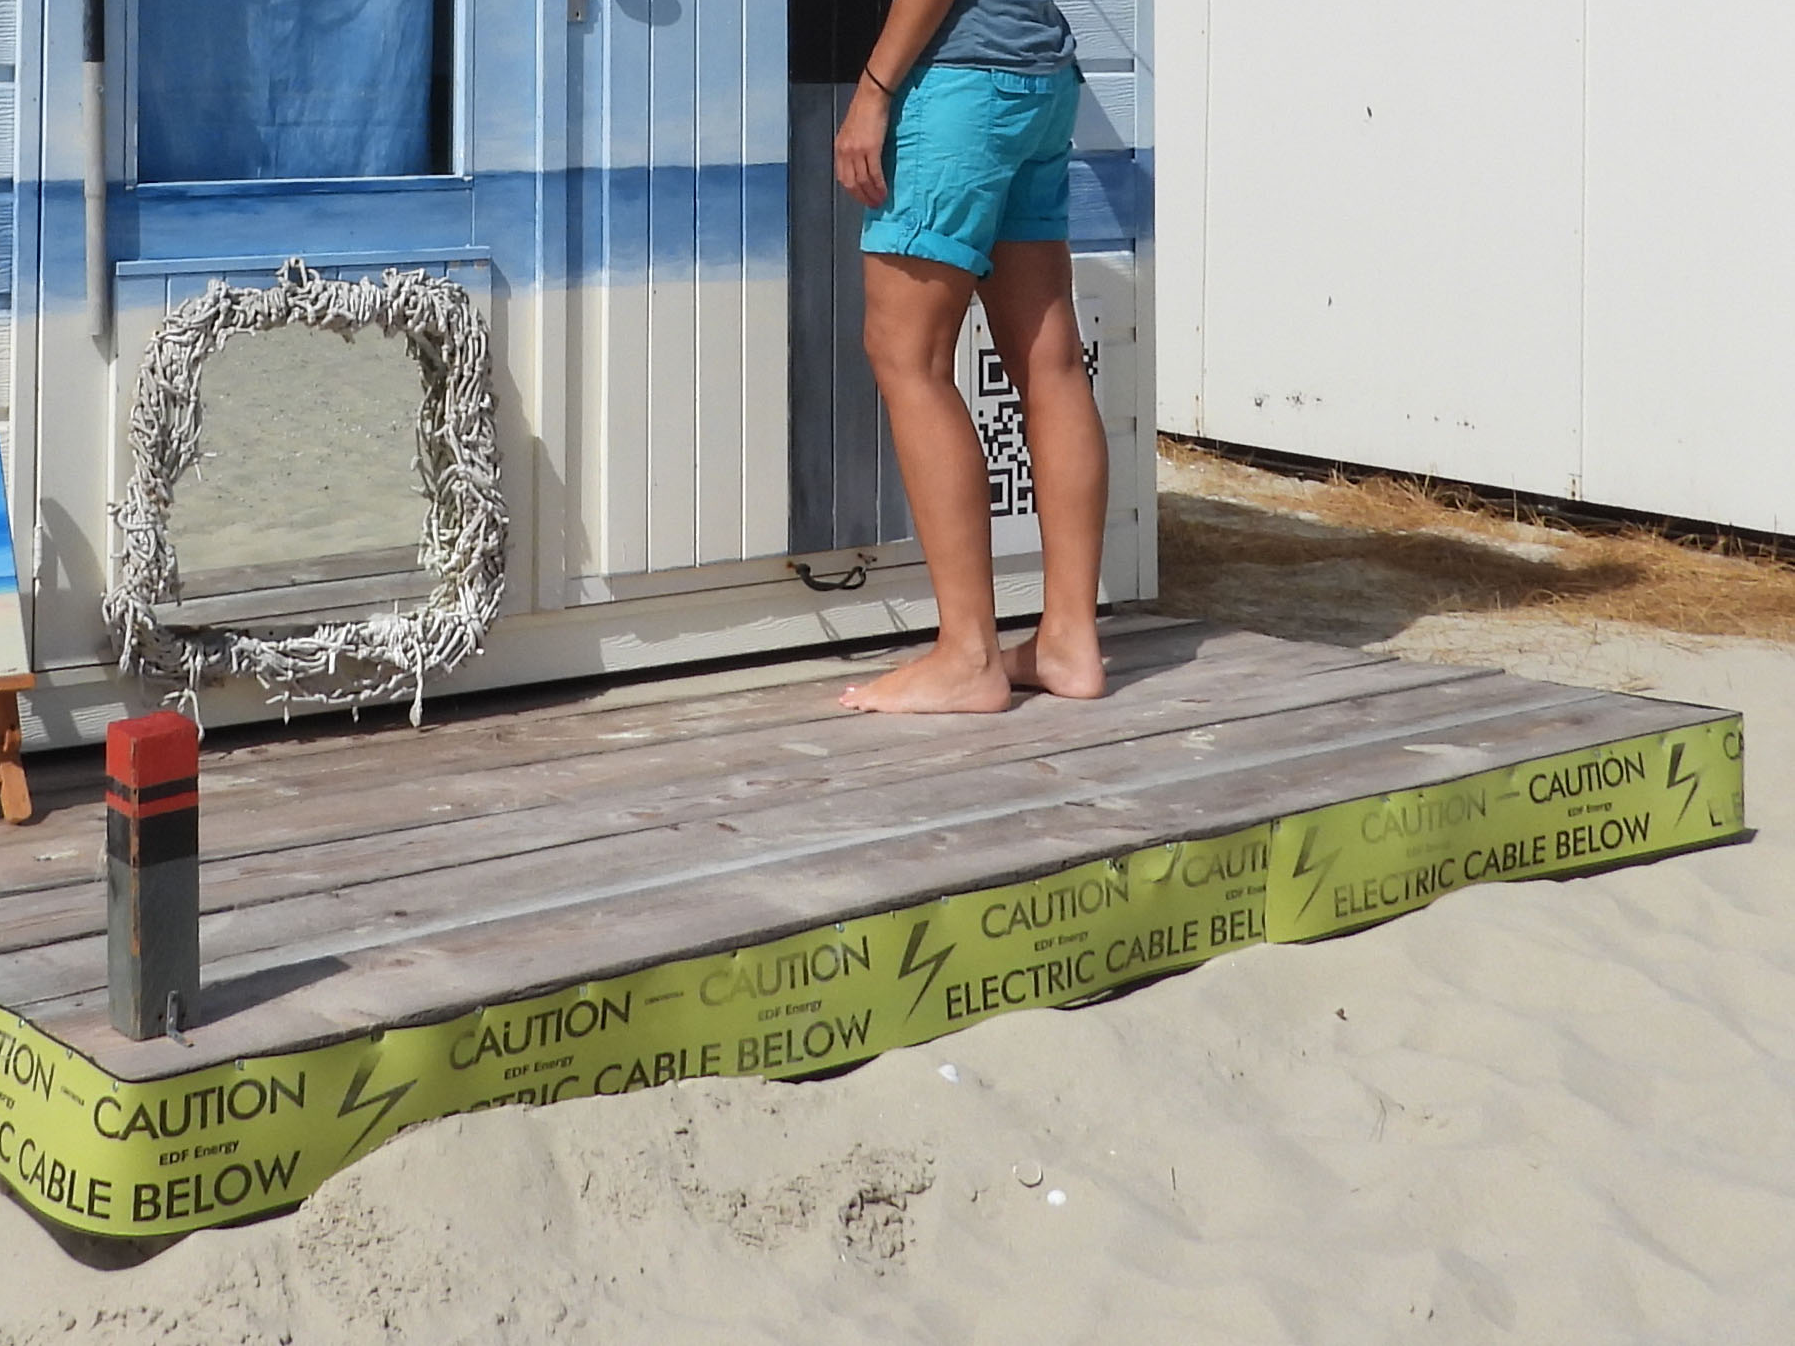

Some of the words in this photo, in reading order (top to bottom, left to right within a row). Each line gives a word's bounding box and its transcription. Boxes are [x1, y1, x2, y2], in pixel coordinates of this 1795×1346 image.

[1362, 788, 1486, 844] CAUTION
[1529, 751, 1646, 804] CAUTION
[981, 866, 1128, 938] CAUTION
[1334, 858, 1455, 918] ELECTRIC
[1464, 839, 1545, 881] CABLE
[1556, 812, 1651, 860] BELOW
[449, 990, 631, 1070] CAUTION
[699, 935, 871, 1006] CAUTION
[946, 950, 1095, 1020] ELECTRIC
[1106, 919, 1198, 975] CABLE
[505, 1064, 531, 1081] EDF
[534, 1055, 574, 1072] Energy
[594, 1043, 721, 1097] CABLE
[738, 1009, 872, 1073] BELOW
[94, 1071, 306, 1140] CAUTION
[19, 1139, 113, 1221] CABLE
[132, 1151, 301, 1223] BELOW
[159, 1149, 189, 1166] EDF
[194, 1140, 240, 1159] Energy
